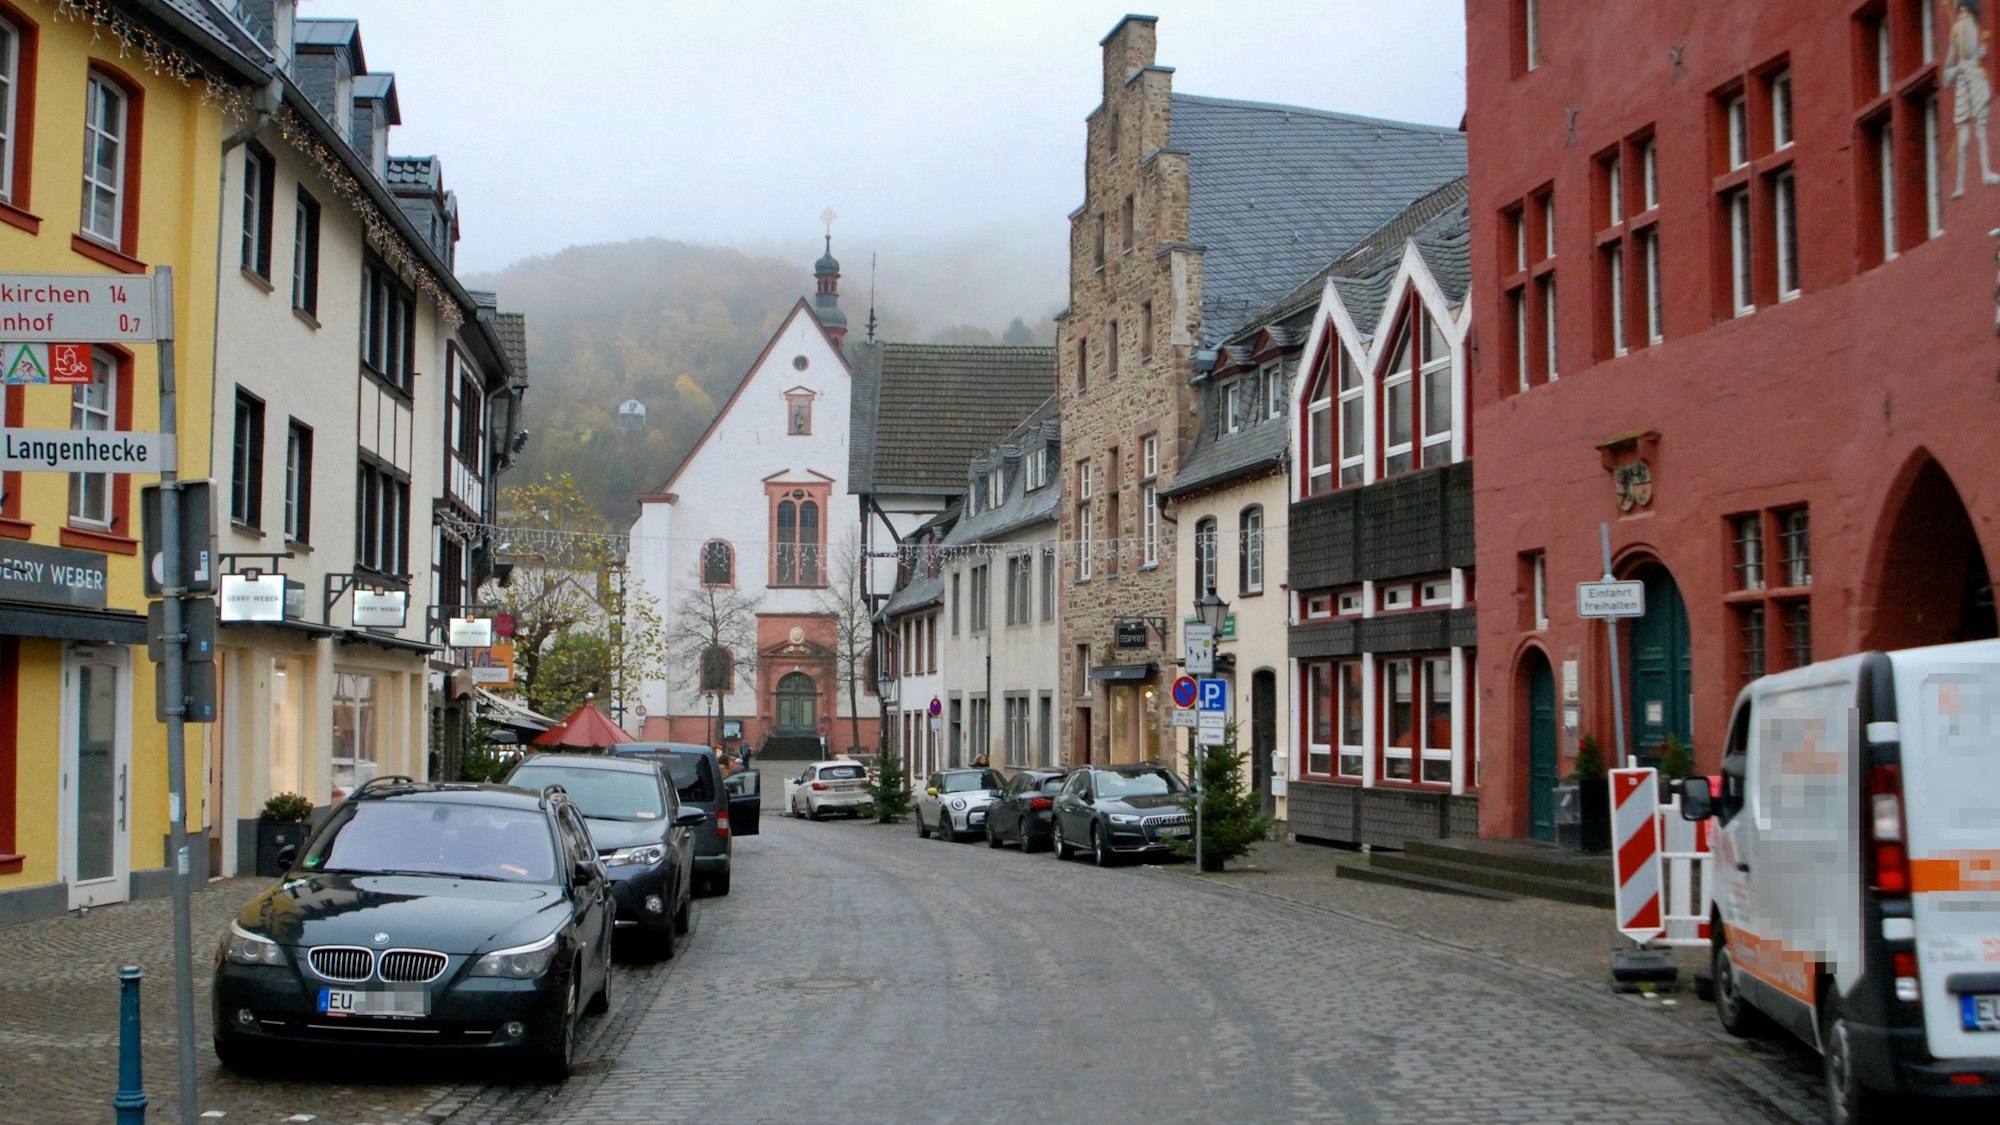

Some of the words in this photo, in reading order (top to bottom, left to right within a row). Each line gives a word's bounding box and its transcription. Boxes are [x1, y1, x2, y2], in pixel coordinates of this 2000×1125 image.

[2, 283, 90, 303] kirchen
[109, 285, 127, 304] 14
[0, 312, 54, 331] nhof
[7, 434, 147, 466] Langenhecke
[0, 557, 45, 583] ERRY
[50, 563, 104, 591] WEBER
[1588, 588, 1632, 598] Einfahrt
[1584, 601, 1637, 611] freihalten
[1119, 634, 1146, 643] ESPRIT
[1204, 683, 1220, 708] P
[330, 992, 353, 1010] EU
